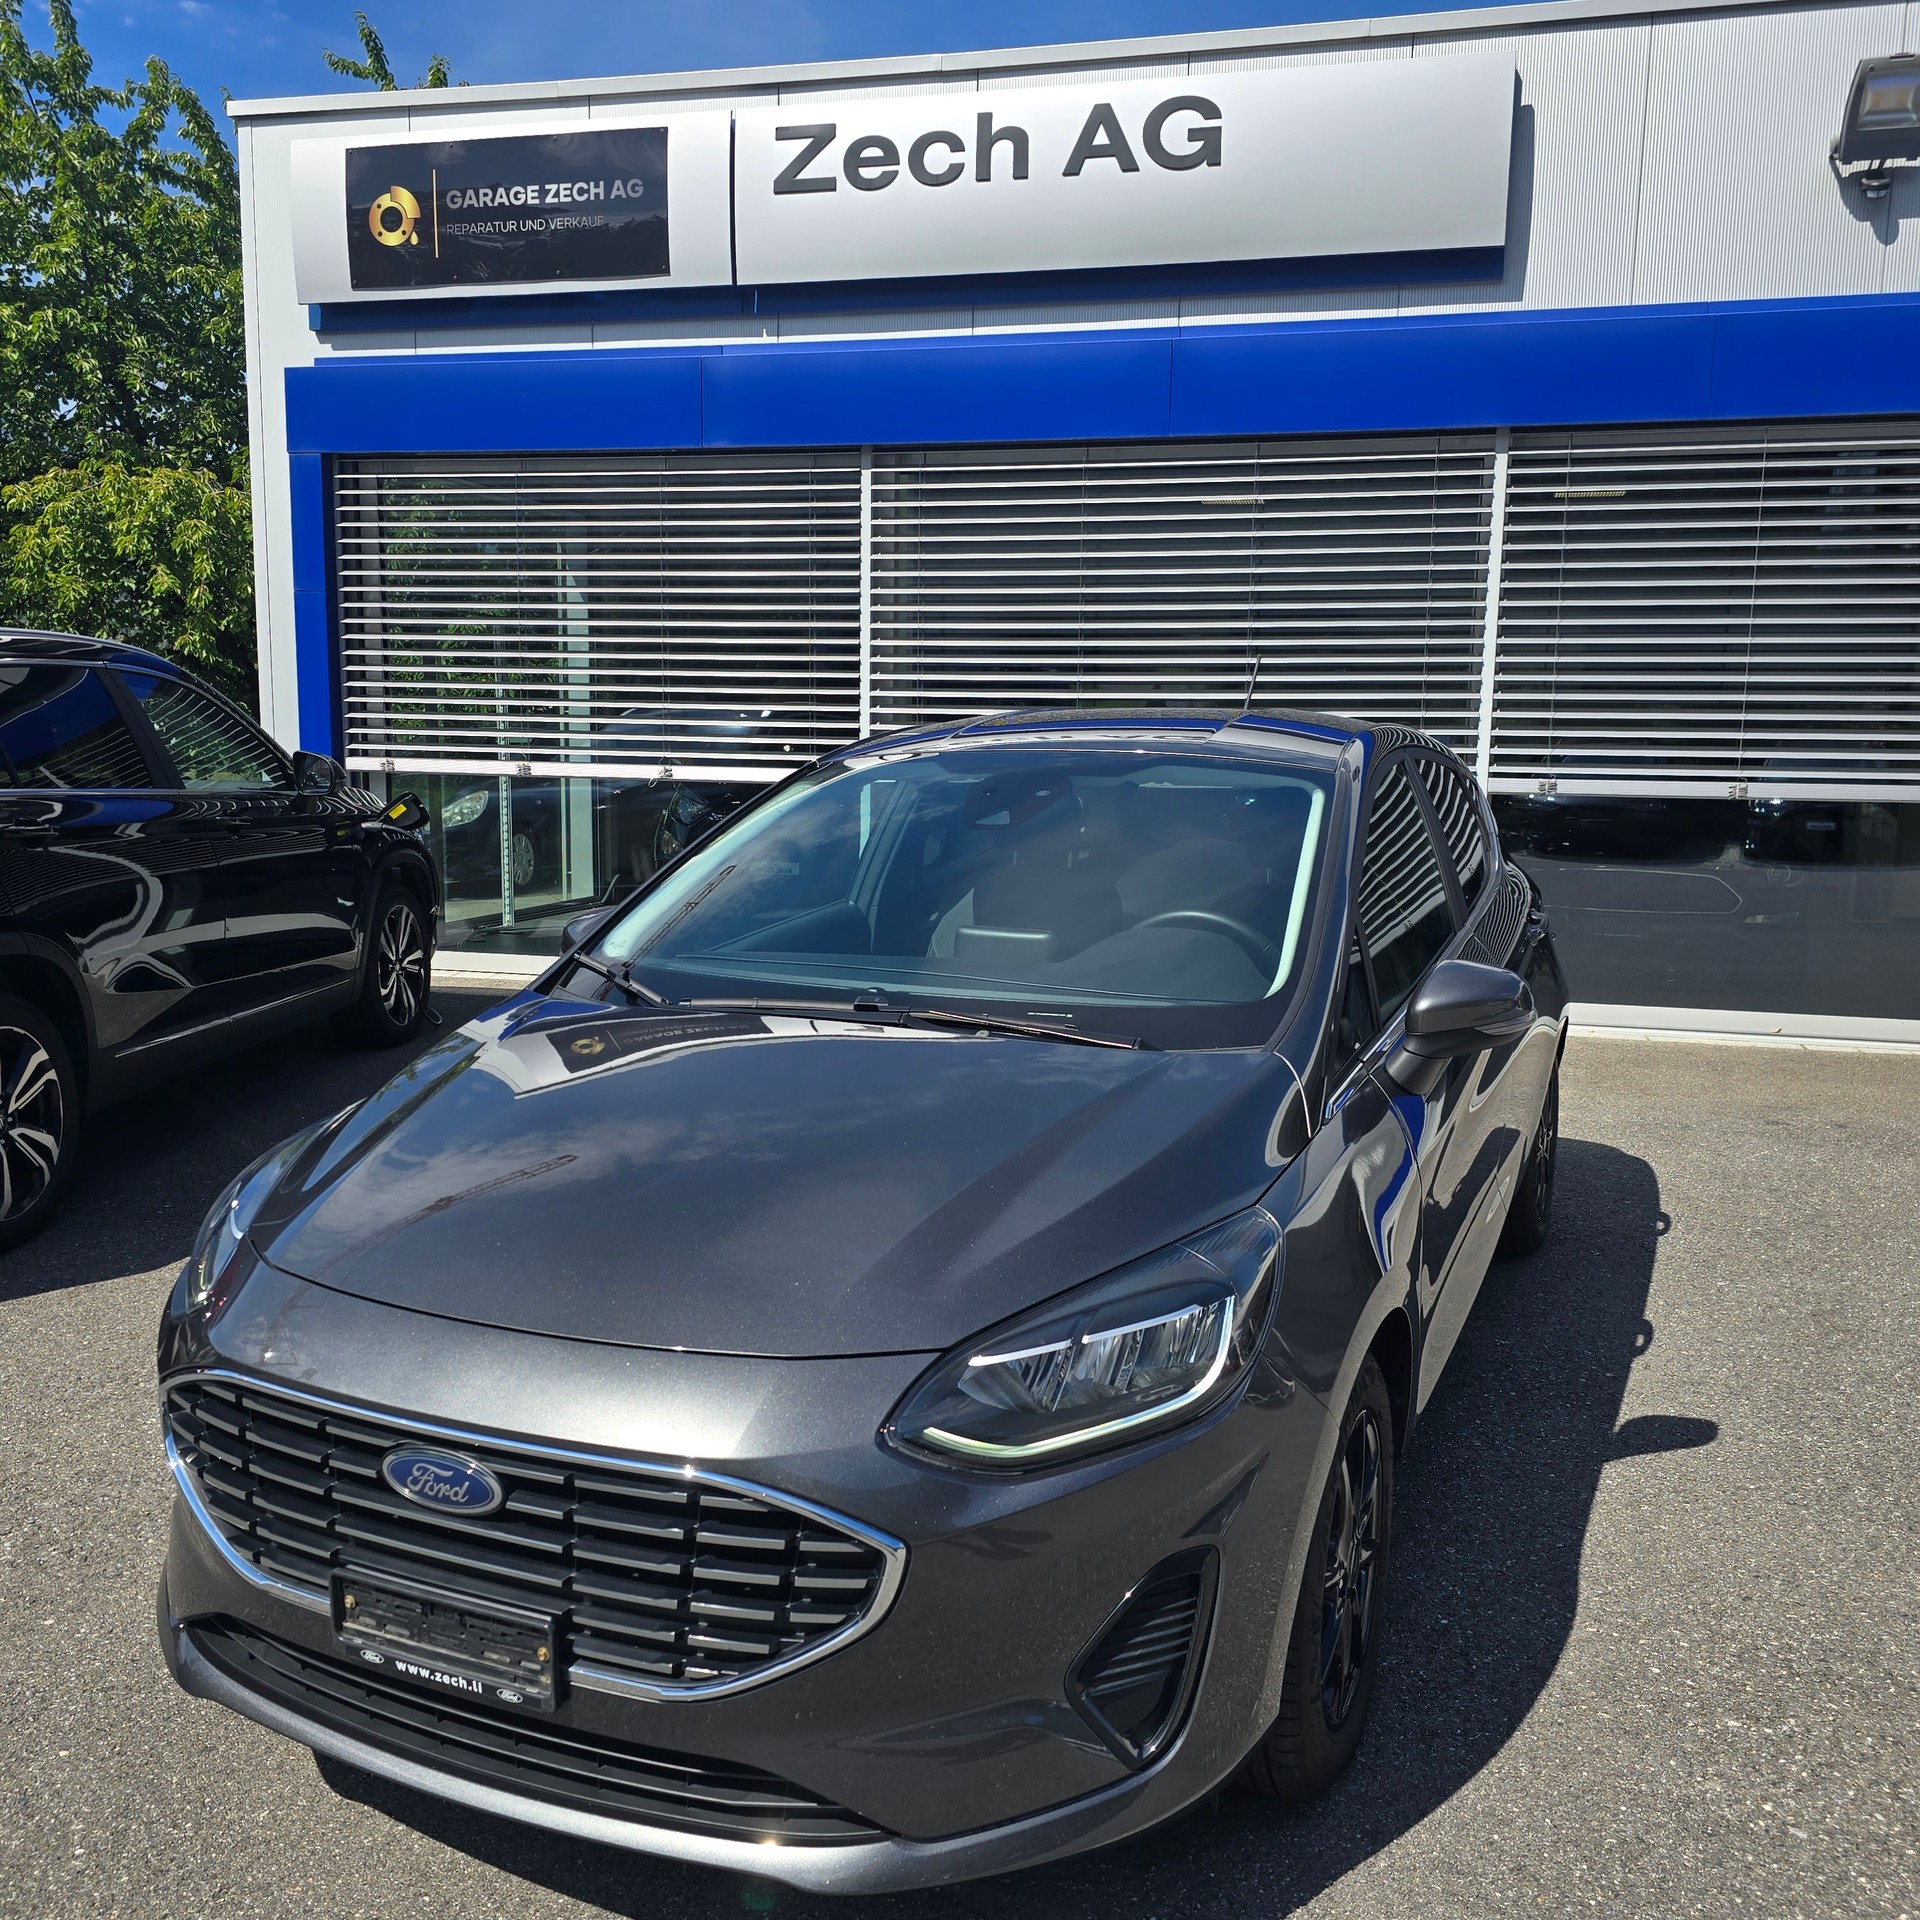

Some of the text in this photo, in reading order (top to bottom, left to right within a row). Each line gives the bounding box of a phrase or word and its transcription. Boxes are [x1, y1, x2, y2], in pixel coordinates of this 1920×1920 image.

[773, 95, 1223, 195] Zech AG
[445, 178, 645, 210] GARAGE ZECH AG
[446, 215, 605, 236] REPARATUR UND VERKAUF
[406, 1462, 470, 1503] Ford
[394, 1660, 483, 1695] www.zech.li
